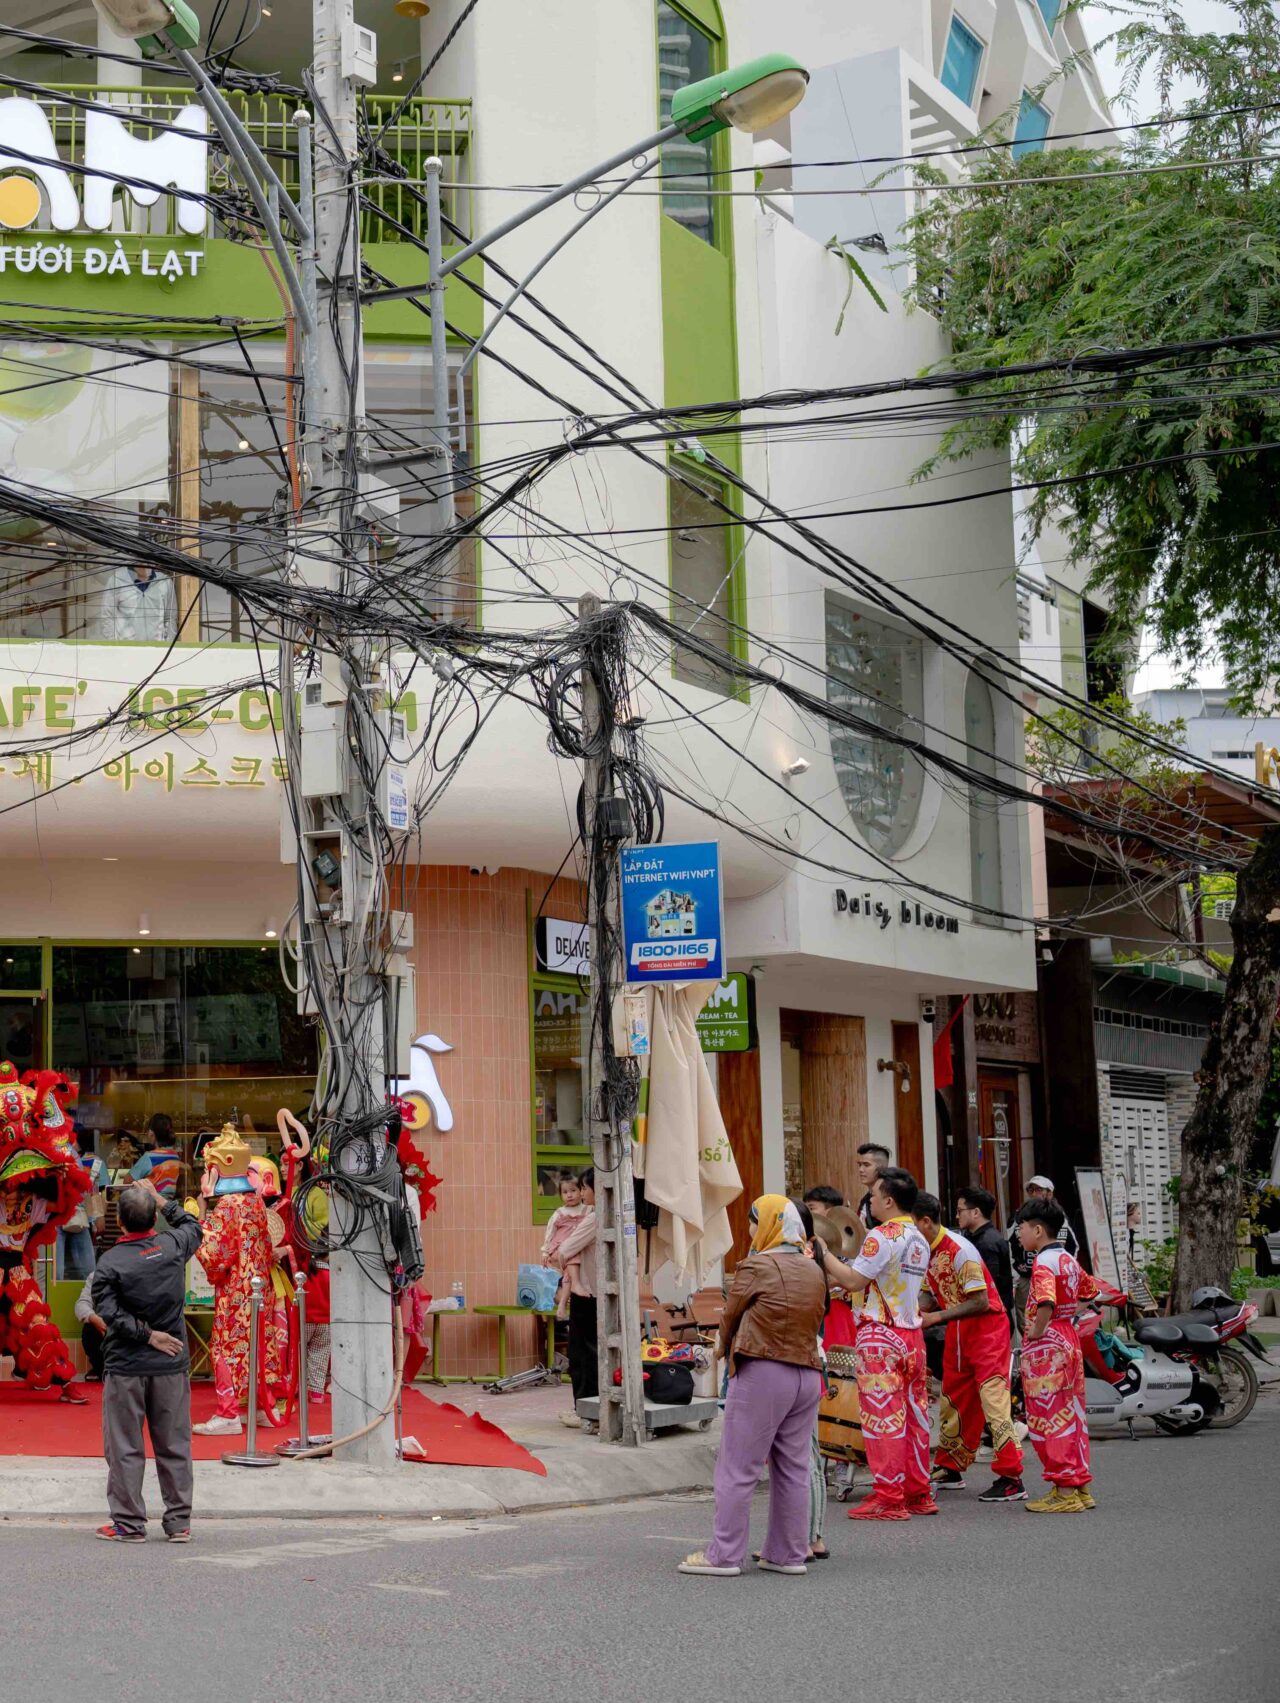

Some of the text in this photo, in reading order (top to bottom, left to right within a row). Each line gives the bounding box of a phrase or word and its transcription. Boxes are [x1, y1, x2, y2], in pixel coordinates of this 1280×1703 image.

[83, 239, 131, 276] ĐÀ
[141, 249, 205, 284] LẠT
[104, 750, 289, 793] 아이스크
[624, 868, 715, 884] INTERNET WIFI VNPT
[835, 888, 959, 934] Daisy bloom
[697, 1012, 720, 1020] REAM
[704, 1147, 722, 1162] Số
